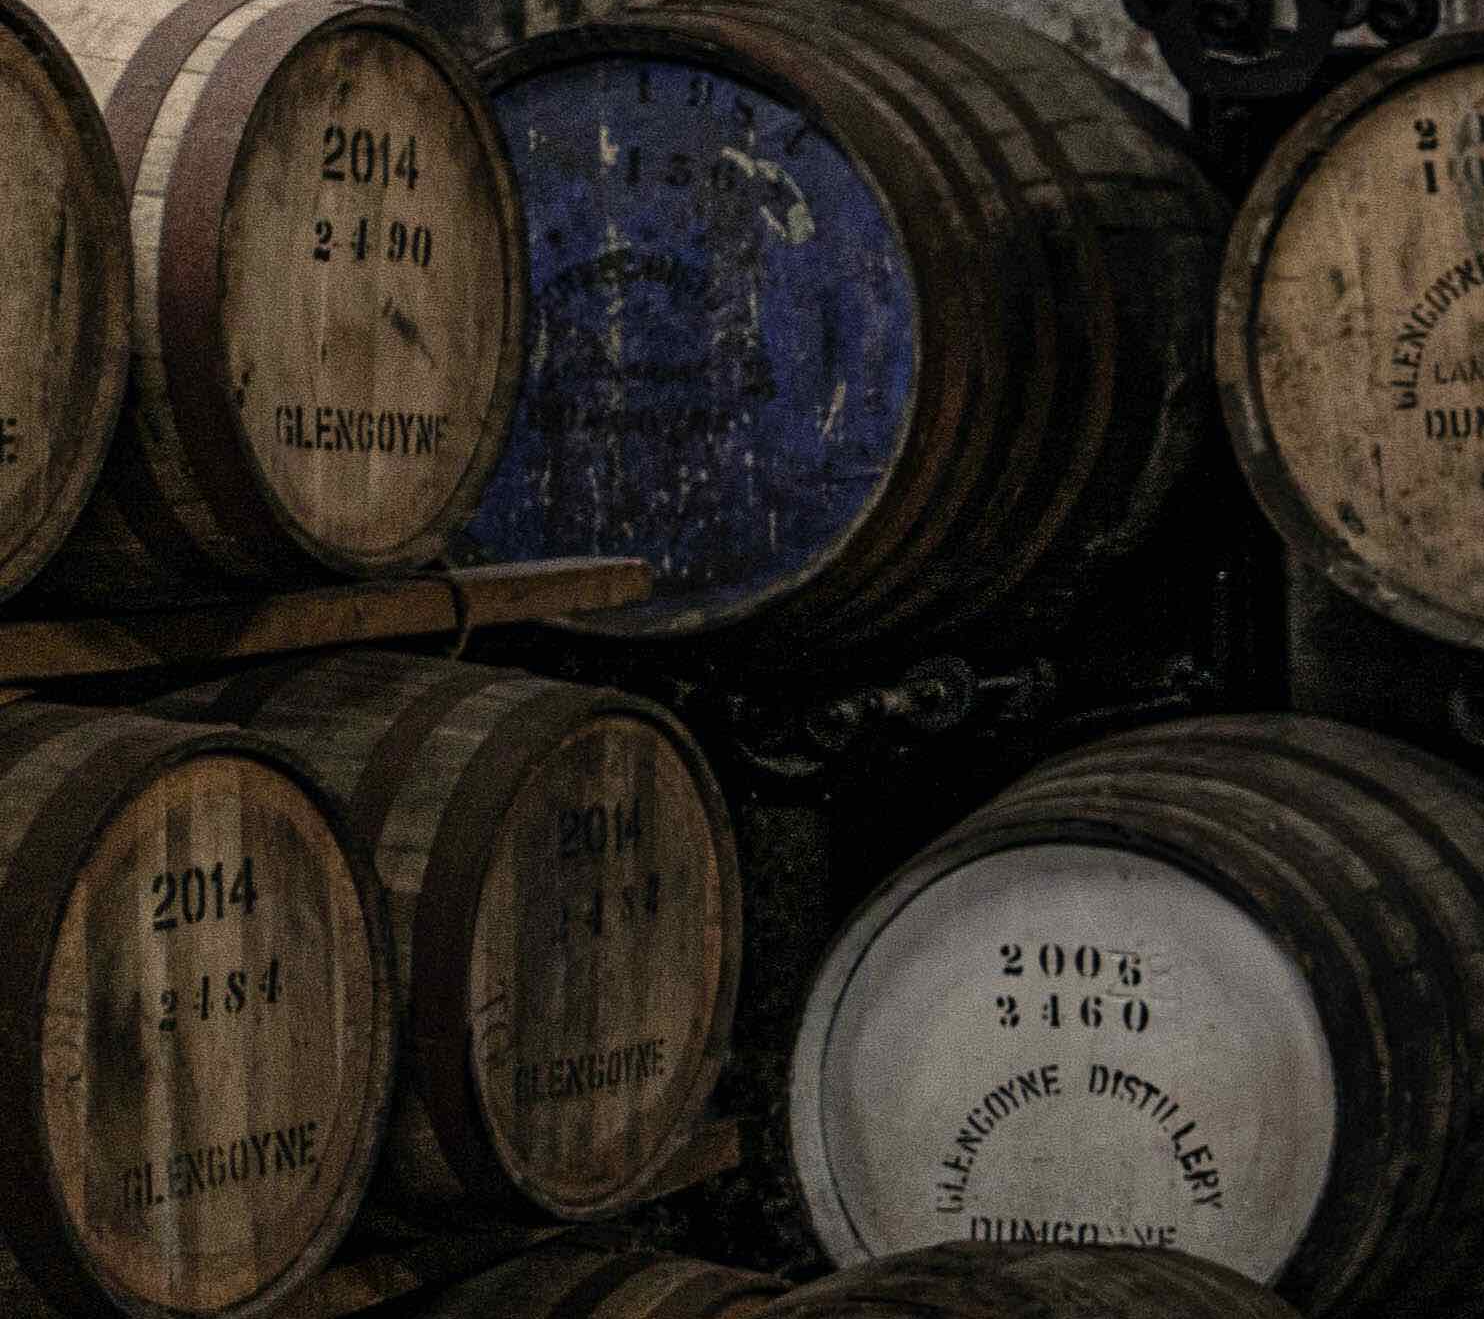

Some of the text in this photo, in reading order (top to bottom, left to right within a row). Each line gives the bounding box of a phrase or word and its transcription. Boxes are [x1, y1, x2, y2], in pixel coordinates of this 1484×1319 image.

[320, 125, 420, 190] 2014
[311, 217, 434, 269] 2490
[274, 405, 451, 455] GLENGOYNE
[152, 856, 257, 931] 2014
[157, 954, 283, 1032] 2484
[122, 1121, 319, 1210] GLENGOYNE
[936, 1064, 1223, 1215] GLENGOYNE DISTILLERY
